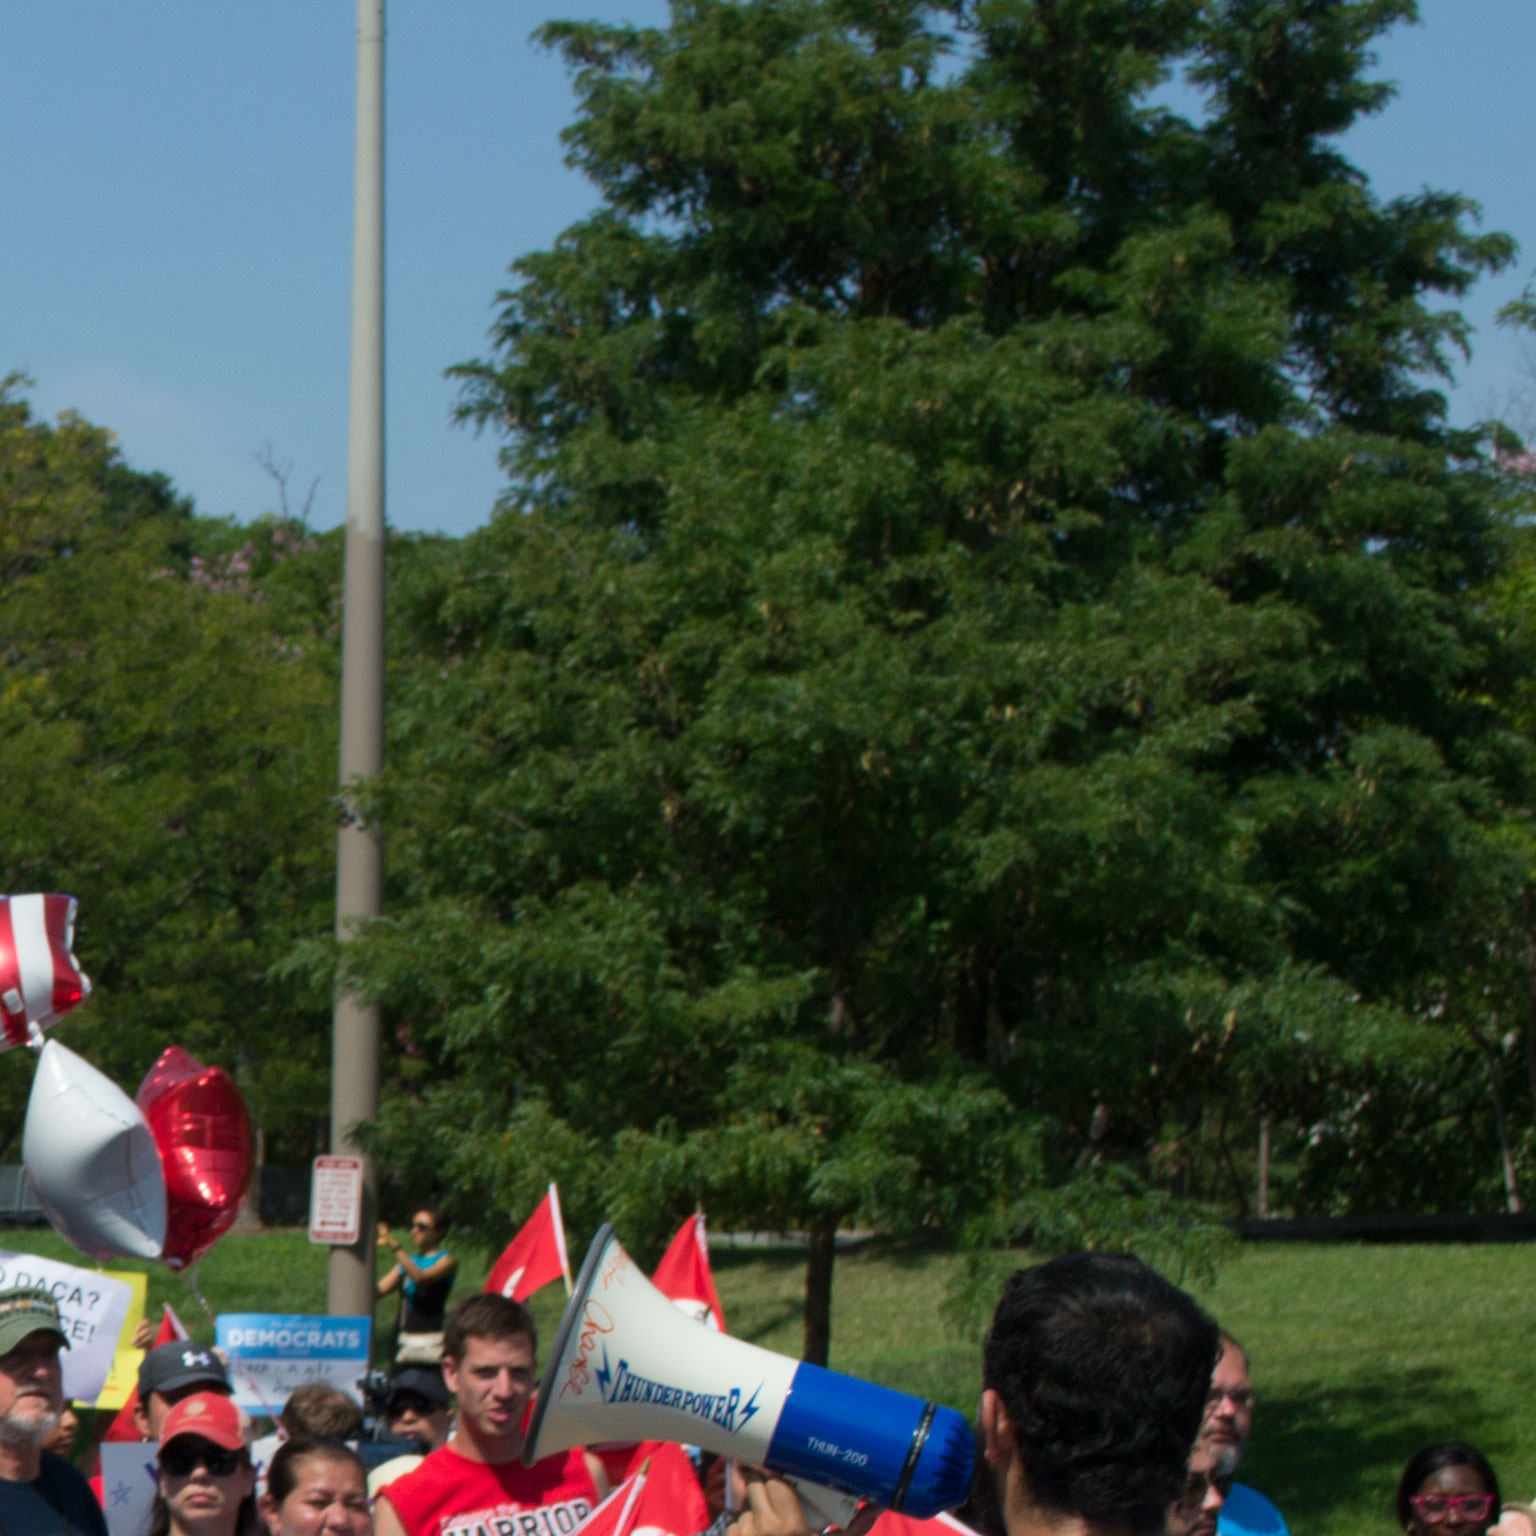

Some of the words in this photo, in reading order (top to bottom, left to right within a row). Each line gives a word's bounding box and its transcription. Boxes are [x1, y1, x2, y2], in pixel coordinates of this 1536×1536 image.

[15, 1272, 101, 1310] DACA?
[228, 1329, 361, 1349] DEMOCRATS
[608, 1359, 741, 1433] THUNDERPOWER
